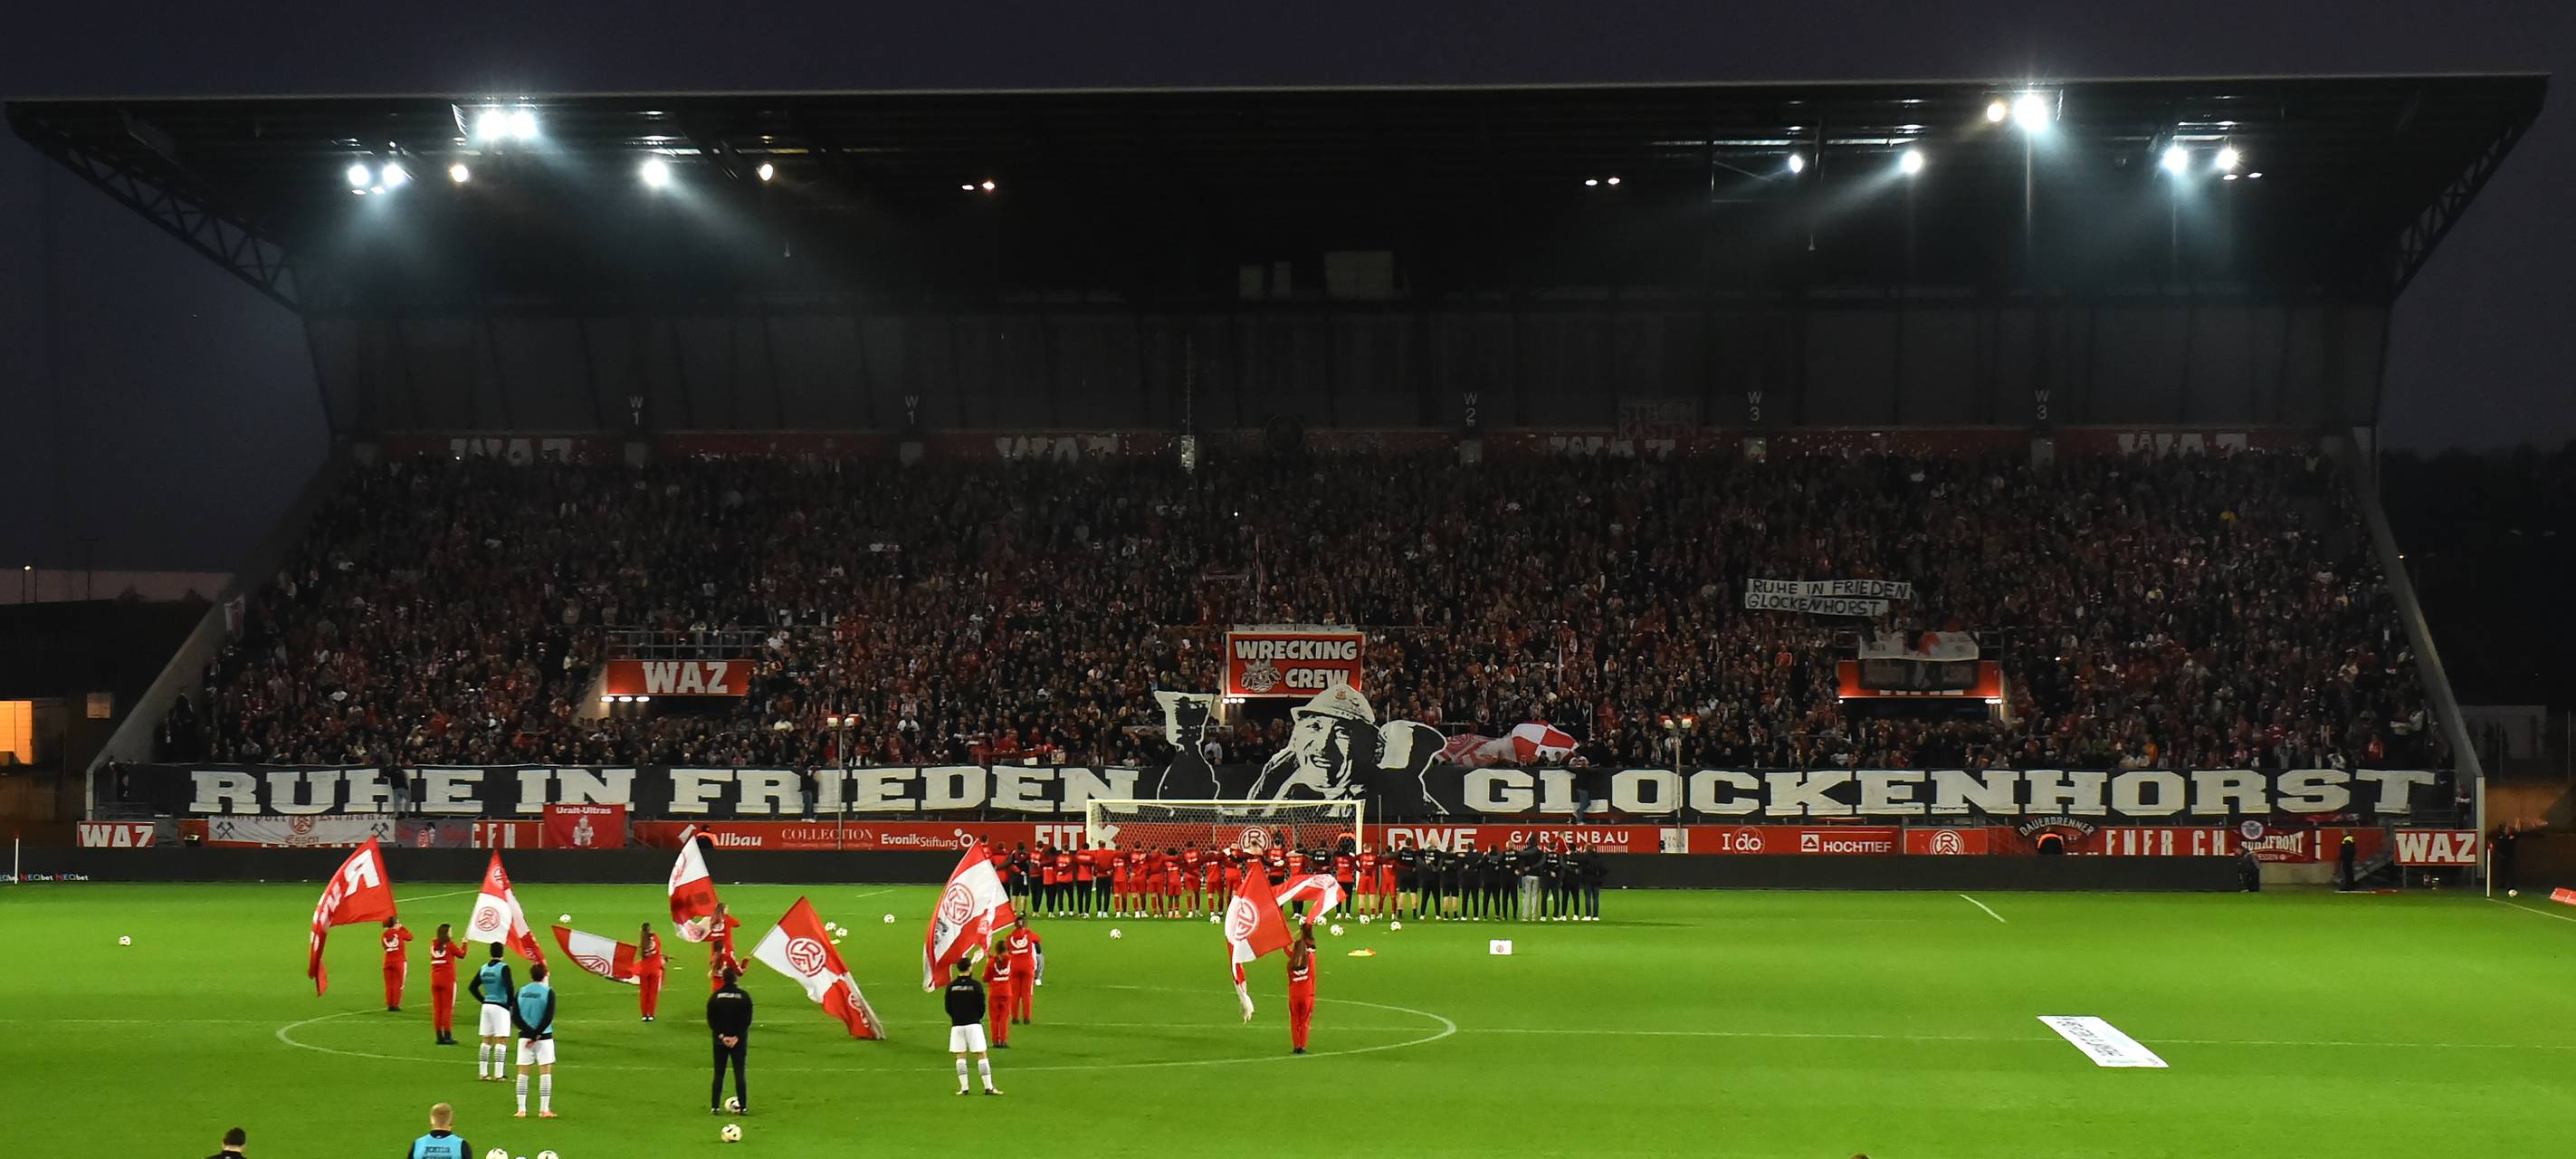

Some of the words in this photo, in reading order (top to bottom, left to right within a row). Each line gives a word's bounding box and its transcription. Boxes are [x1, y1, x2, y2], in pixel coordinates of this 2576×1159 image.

[630, 396, 644, 408] W
[905, 396, 919, 408] W
[1463, 393, 1477, 406] W
[1748, 391, 1761, 404] W
[2036, 389, 2049, 402] W
[633, 411, 638, 426] 1
[908, 411, 914, 425] 1
[1465, 408, 1476, 421] 2
[1750, 407, 1760, 421] 3
[2037, 406, 2047, 419] 3
[1753, 580, 1798, 595] RUHE
[1807, 581, 1825, 595] IN
[1832, 581, 1909, 599] FRIEDEN
[1747, 594, 1881, 616] GLOCKENHORST
[1235, 640, 1357, 660] WRECKING
[642, 661, 728, 694] WAZ
[1285, 668, 1350, 689] CREW
[188, 769, 484, 814] RUHE
[515, 768, 636, 813] IN
[668, 766, 1140, 814] FRIEDEN
[1463, 768, 2436, 817] GLOCKENHORST
[2018, 817, 2094, 837] DAUERBRENNER
[80, 825, 154, 848] WAZ
[716, 833, 762, 846] llbau
[781, 829, 873, 840] COLLECTION
[1388, 828, 1477, 853] RWE
[1722, 833, 1731, 850] I
[1735, 833, 1761, 850] do
[1823, 840, 1892, 853] HOCHTIEF
[2396, 833, 2476, 863] WAZ
